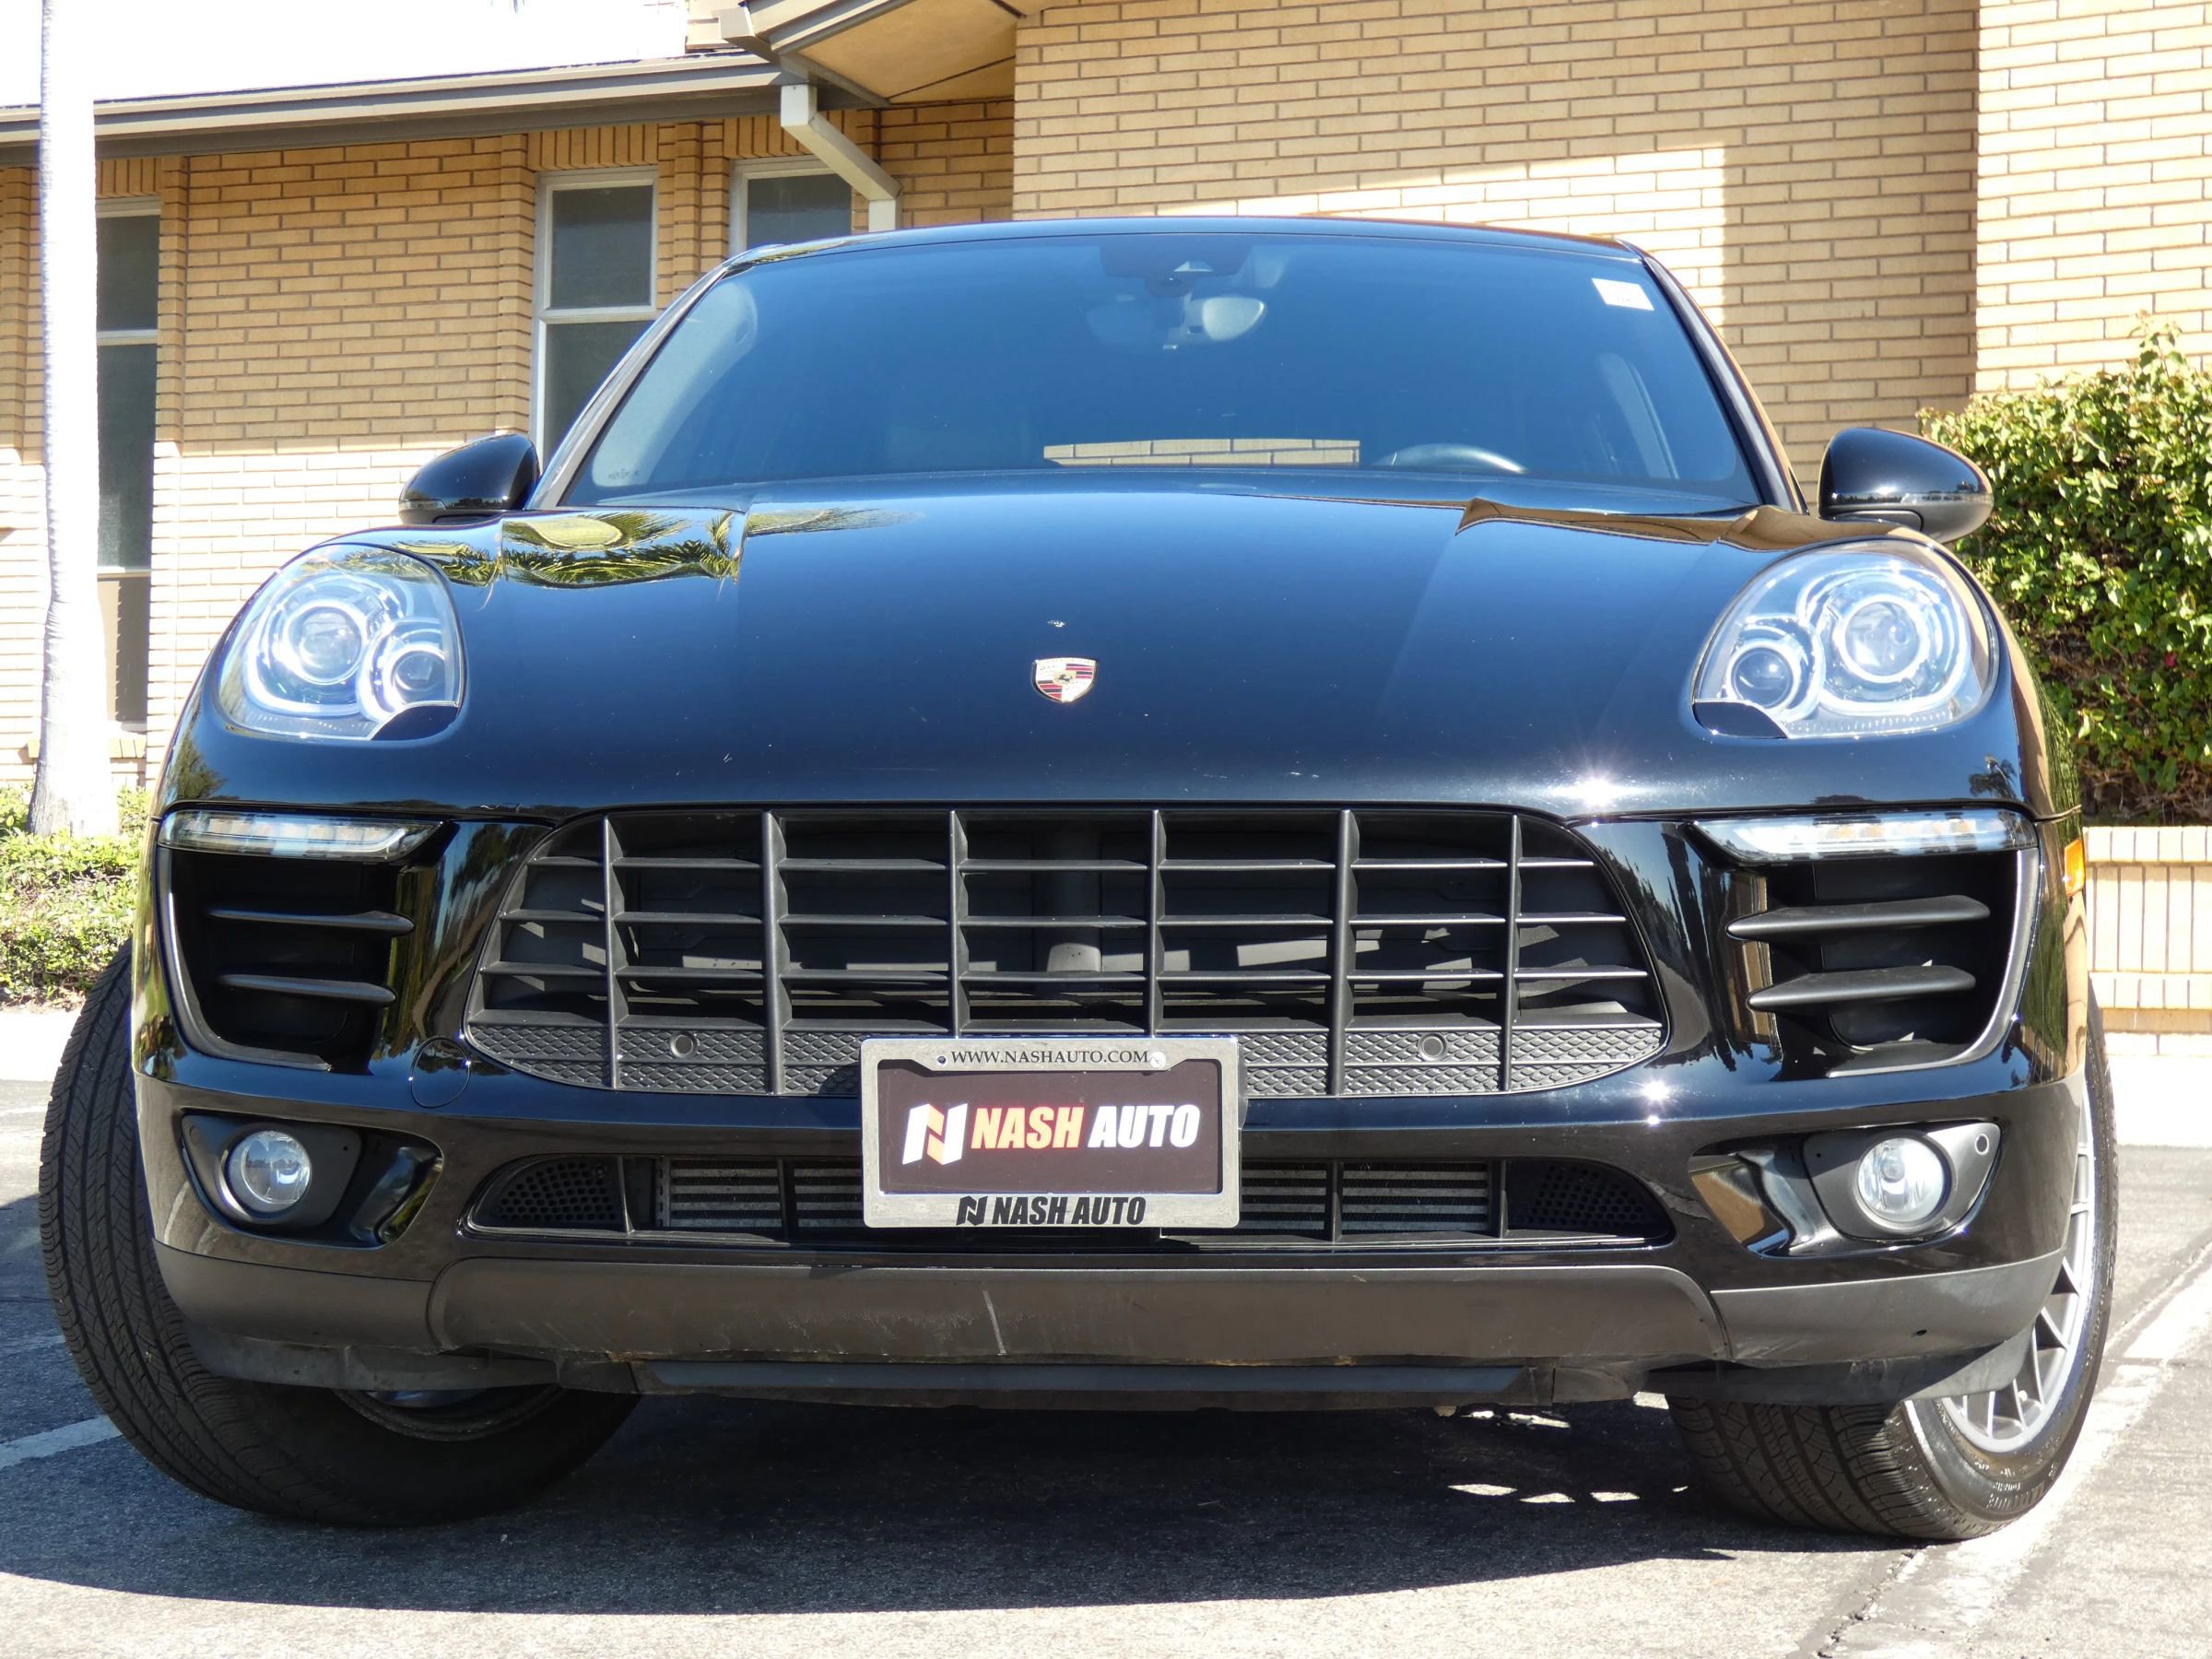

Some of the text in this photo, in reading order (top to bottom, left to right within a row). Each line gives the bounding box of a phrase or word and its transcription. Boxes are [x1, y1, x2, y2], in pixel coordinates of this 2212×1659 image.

[951, 1051, 1148, 1064] WWW.NASHAUTO.COM
[971, 1107, 1085, 1149] NASH
[1088, 1104, 1201, 1147] AUTO
[992, 1196, 1071, 1225] NASH
[1071, 1196, 1147, 1225] AUTO
